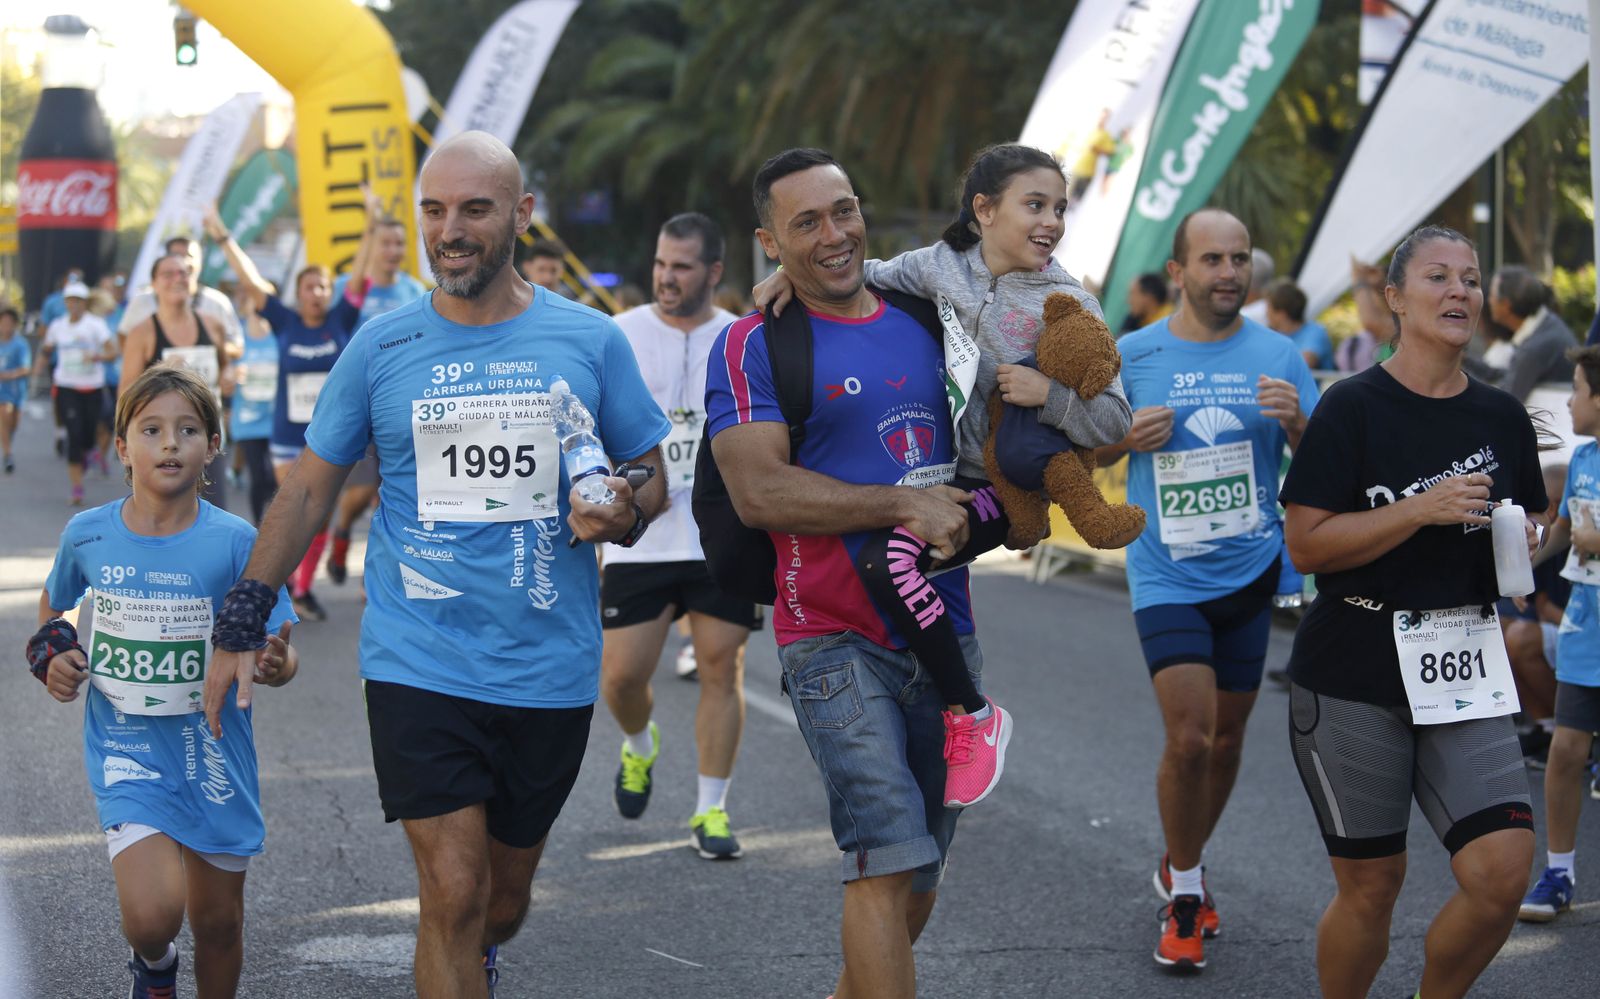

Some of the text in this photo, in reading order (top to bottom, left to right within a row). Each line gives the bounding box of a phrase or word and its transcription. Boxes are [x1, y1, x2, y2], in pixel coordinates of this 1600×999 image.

[380, 334, 412, 350] luanvi
[489, 361, 533, 371] RENAULT
[423, 378, 543, 398] CARRERA URBANA
[1169, 386, 1252, 398] CARRERA URBANA
[463, 399, 551, 409] CARRERA URBANA
[1166, 395, 1257, 407] CIUDAD DE MÁLAGA
[458, 410, 549, 420] CIUDAD DE MÁLAG
[423, 423, 458, 431] RENAULT
[1183, 452, 1251, 469] CIUDAD DE MÁLAGA
[1185, 449, 1217, 461] CARRERA
[441, 444, 537, 479] 1995
[909, 469, 941, 480] CARRERA
[1164, 482, 1248, 516] 22699
[420, 547, 453, 559] MÁLAGA
[510, 525, 524, 588] Renault
[148, 571, 188, 580] RENAULT
[126, 603, 208, 613] CARRERA URBANA
[1436, 608, 1469, 618] CARRERA
[122, 614, 156, 623] CIUDAD
[173, 614, 211, 623] MÁLAGA
[1433, 620, 1463, 629] CIUDAD
[1464, 619, 1471, 627] DE
[1404, 632, 1434, 640] RENAULT
[94, 642, 201, 682] 23846
[1420, 648, 1487, 684] 8681
[182, 726, 196, 780] Renault
